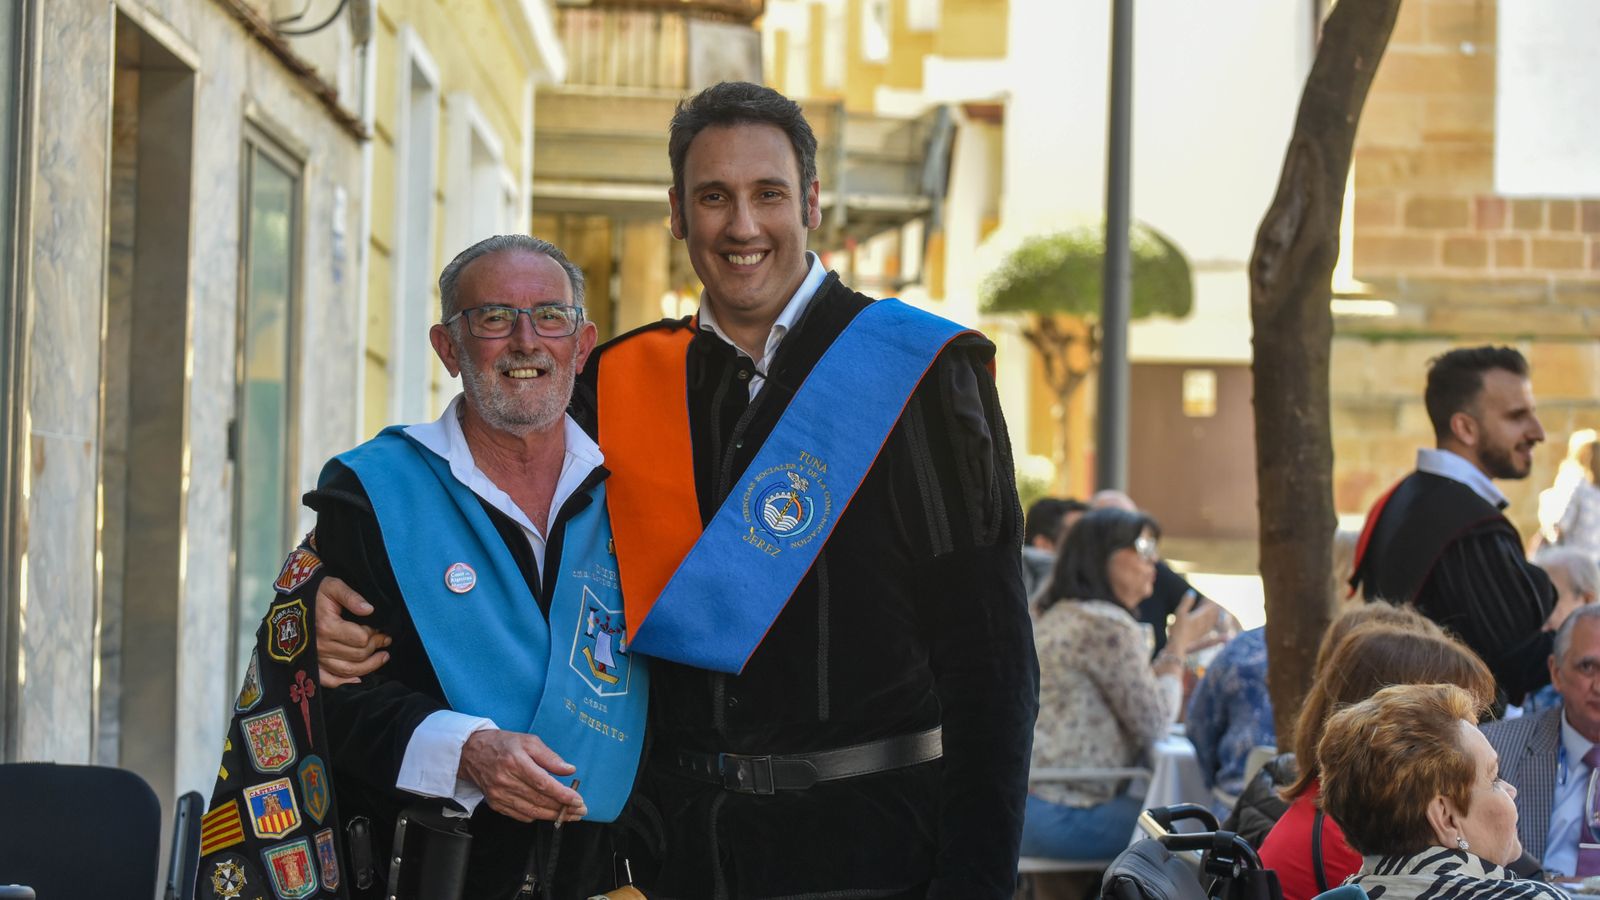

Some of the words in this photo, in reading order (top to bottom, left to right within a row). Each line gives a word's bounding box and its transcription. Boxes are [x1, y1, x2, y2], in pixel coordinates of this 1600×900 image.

[800, 450, 828, 473] TUNA
[743, 483, 756, 523] CIENCIAS
[755, 463, 797, 482] SOCIALES
[807, 469, 819, 479] DE
[817, 478, 827, 490] LA
[743, 526, 782, 558] JEREZ
[272, 607, 303, 624] GIBRALTAR
[248, 714, 282, 728] GRANADA
[249, 783, 288, 797] CASTELLON
